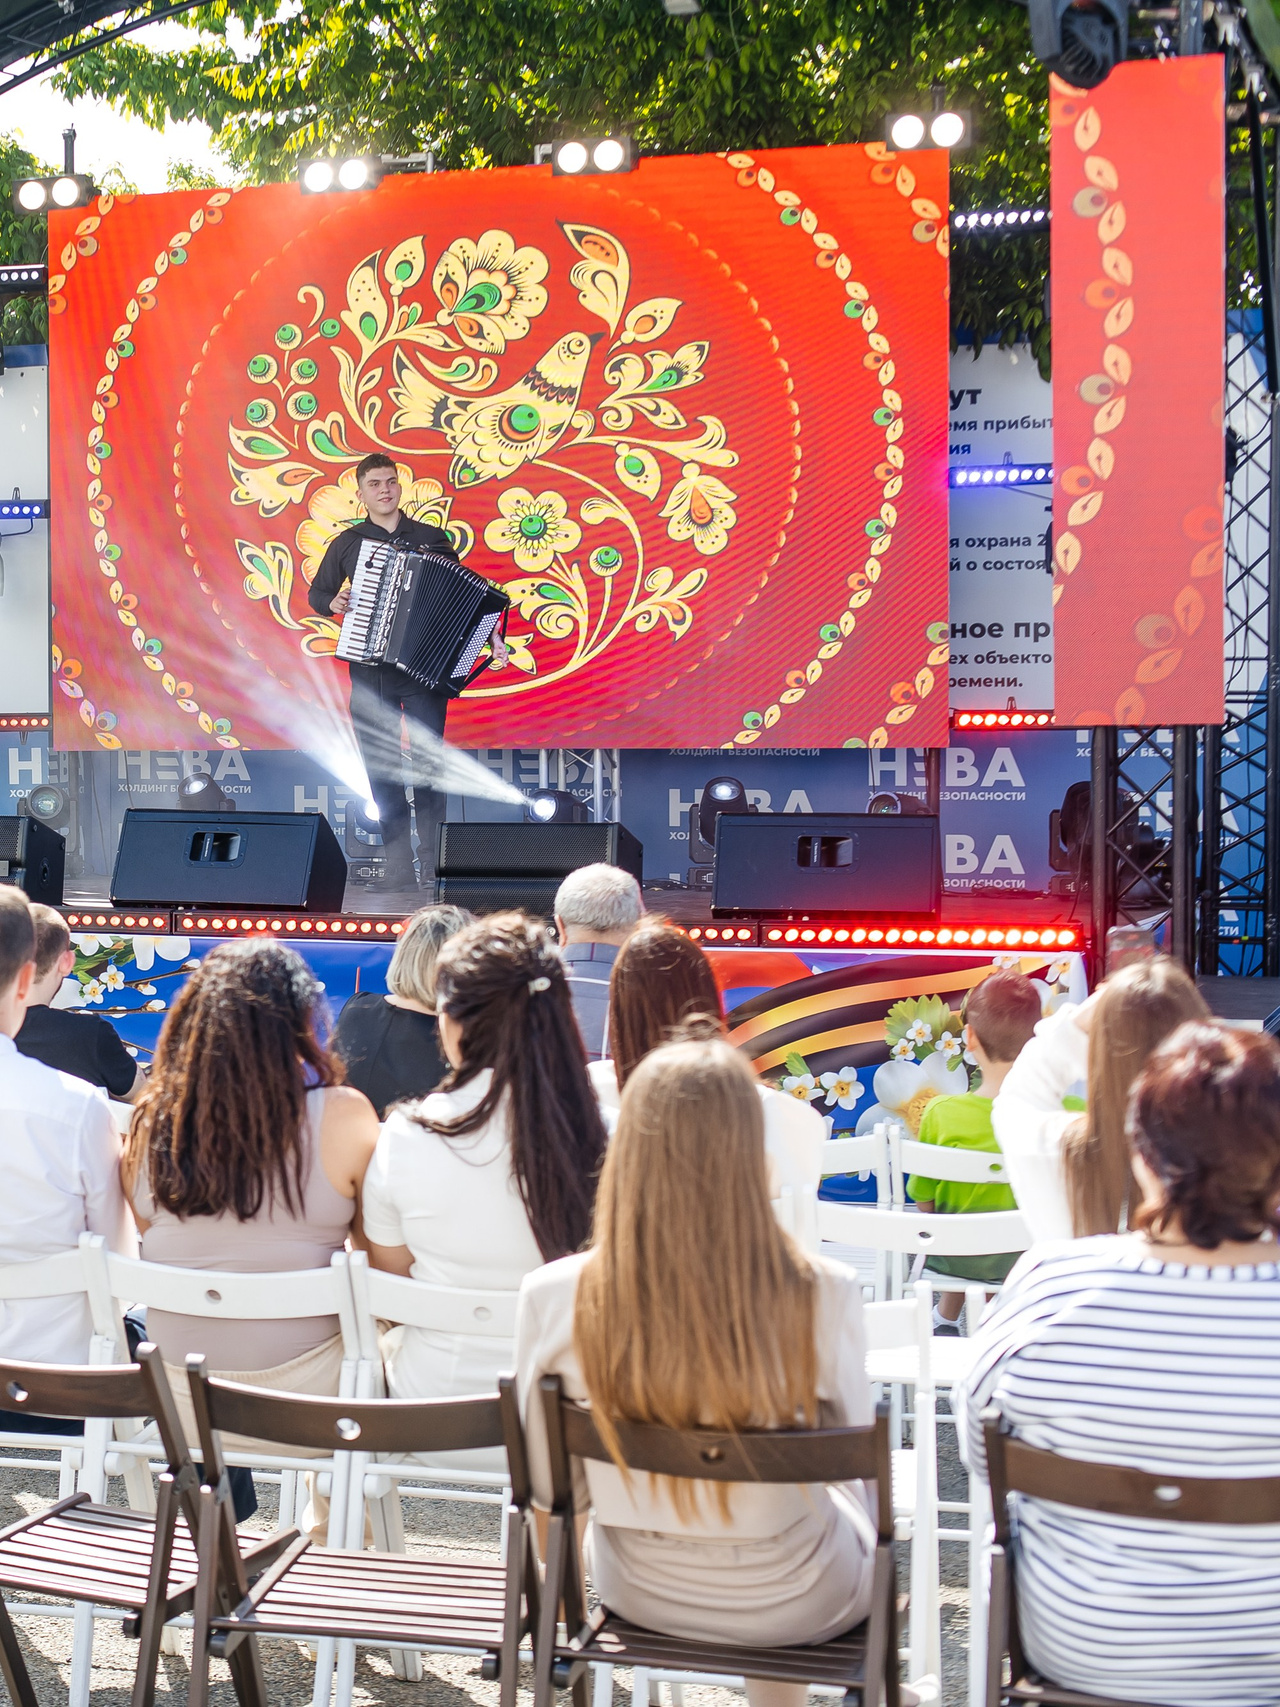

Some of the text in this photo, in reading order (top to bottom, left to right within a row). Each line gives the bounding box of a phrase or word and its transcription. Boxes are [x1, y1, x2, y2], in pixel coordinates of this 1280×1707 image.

[965, 536, 1032, 550] охрана
[966, 560, 977, 571] о
[728, 748, 820, 757] БЕЗОПАСНОСТИ
[118, 784, 167, 794] ХОЛДИНГ
